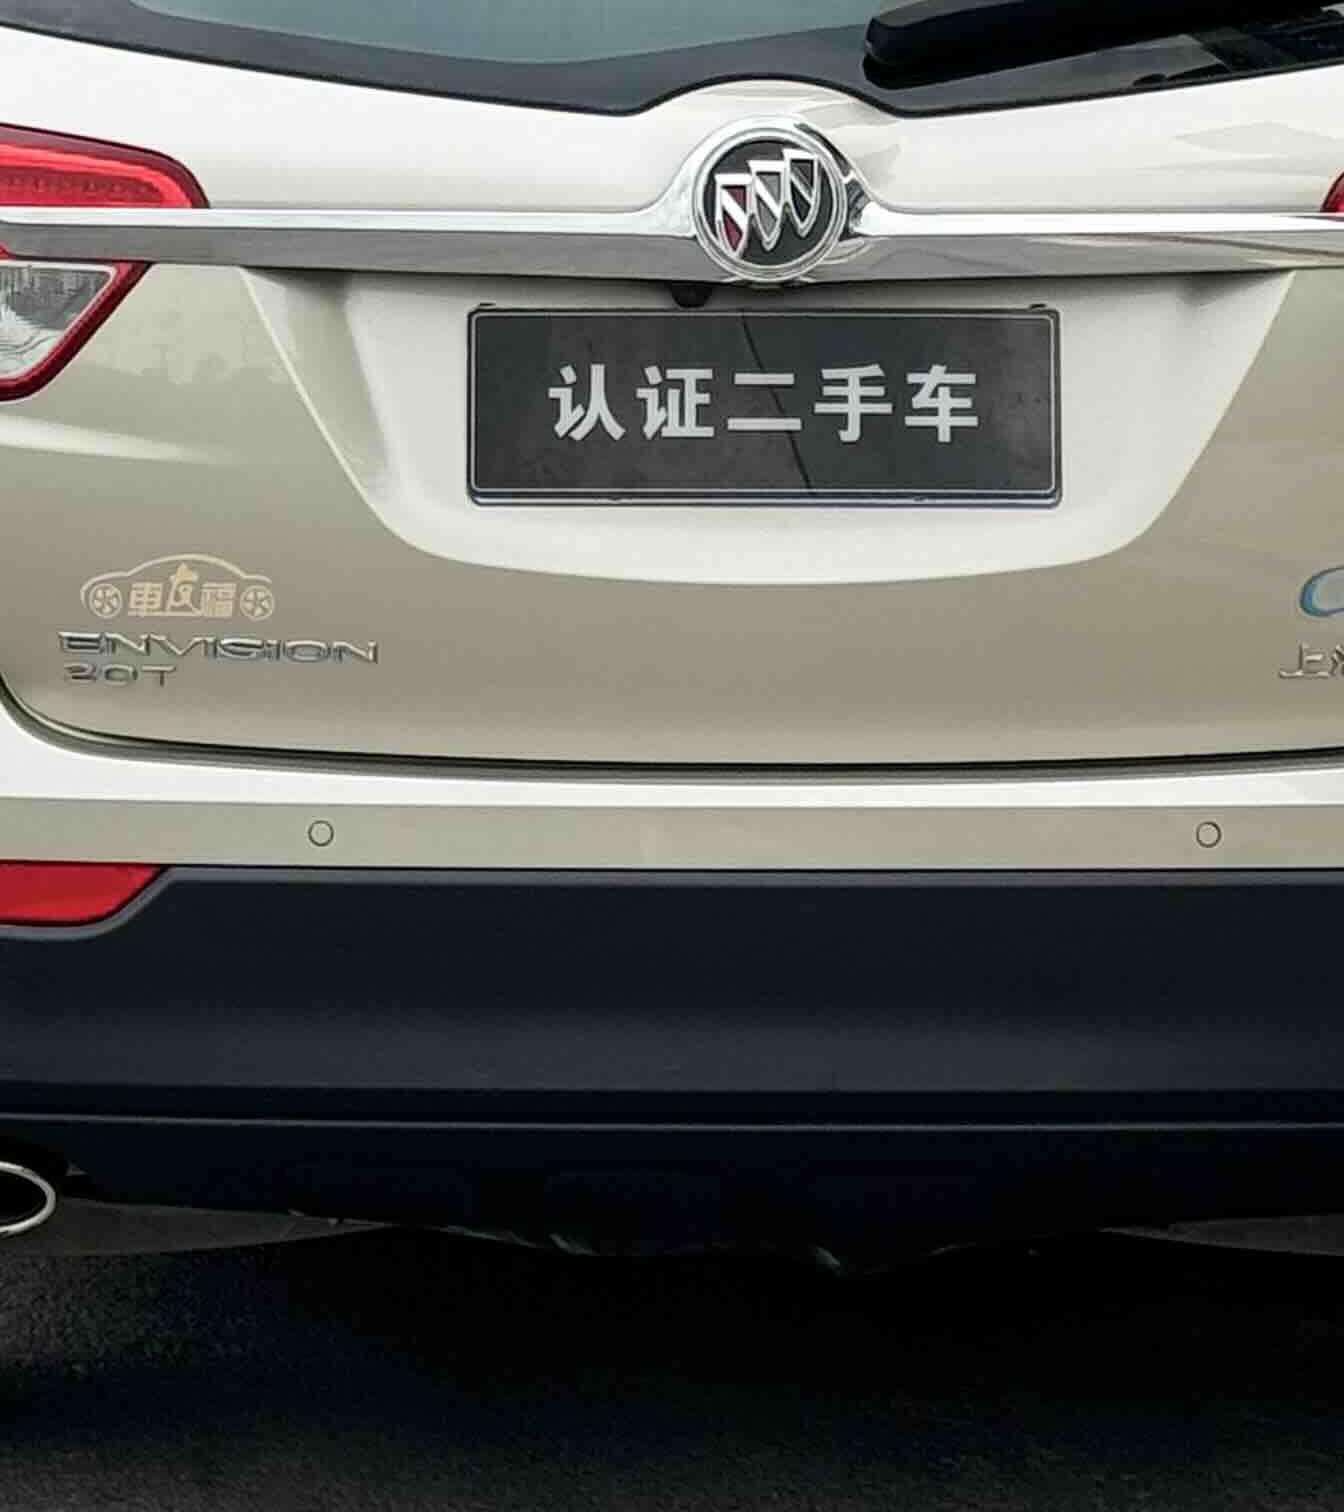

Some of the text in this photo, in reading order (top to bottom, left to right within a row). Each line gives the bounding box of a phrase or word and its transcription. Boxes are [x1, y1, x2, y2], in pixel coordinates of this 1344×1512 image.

[548, 363, 978, 442] 认证二手车
[58, 631, 378, 664] ENVISION
[62, 663, 177, 687] 20T
